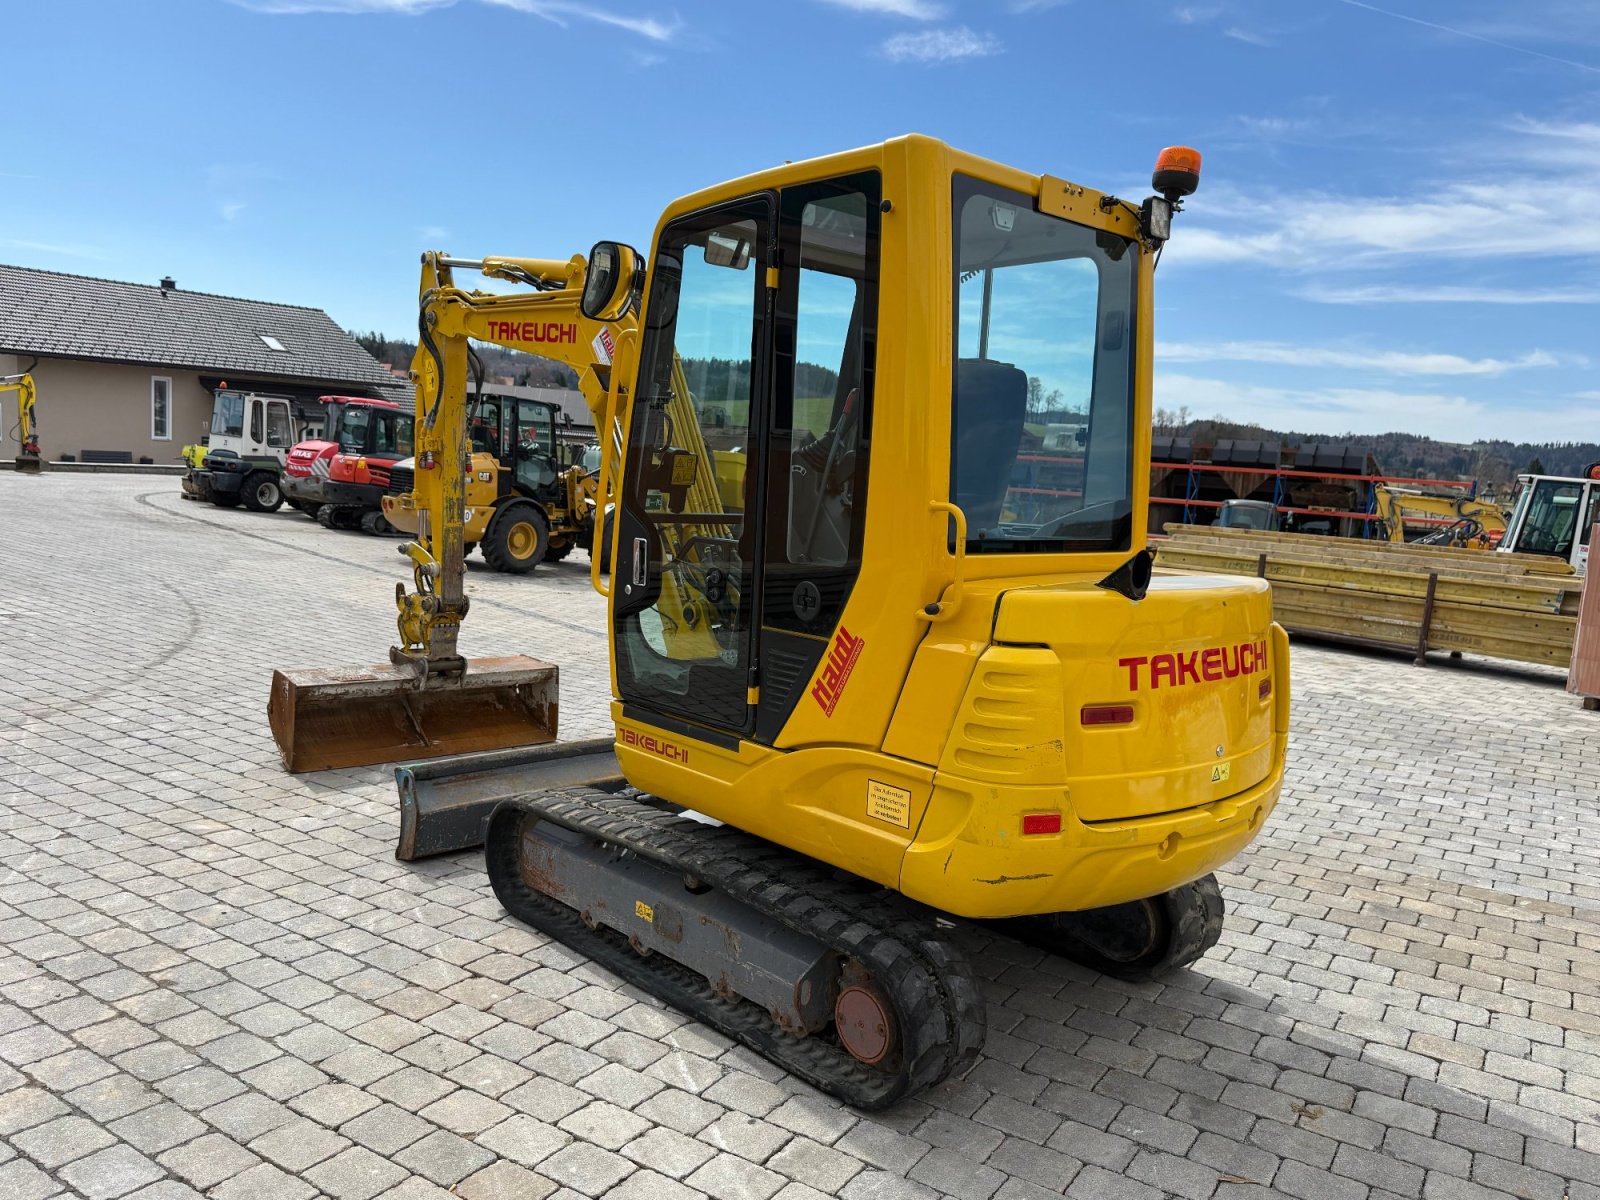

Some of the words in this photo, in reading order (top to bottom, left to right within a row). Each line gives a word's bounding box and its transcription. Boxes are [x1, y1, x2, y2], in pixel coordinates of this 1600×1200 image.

[488, 321, 577, 344] TAKEUCHI
[478, 472, 490, 481] CAT
[1118, 640, 1267, 692] TAKEUCHI
[619, 727, 689, 764] TAKEUCHI
